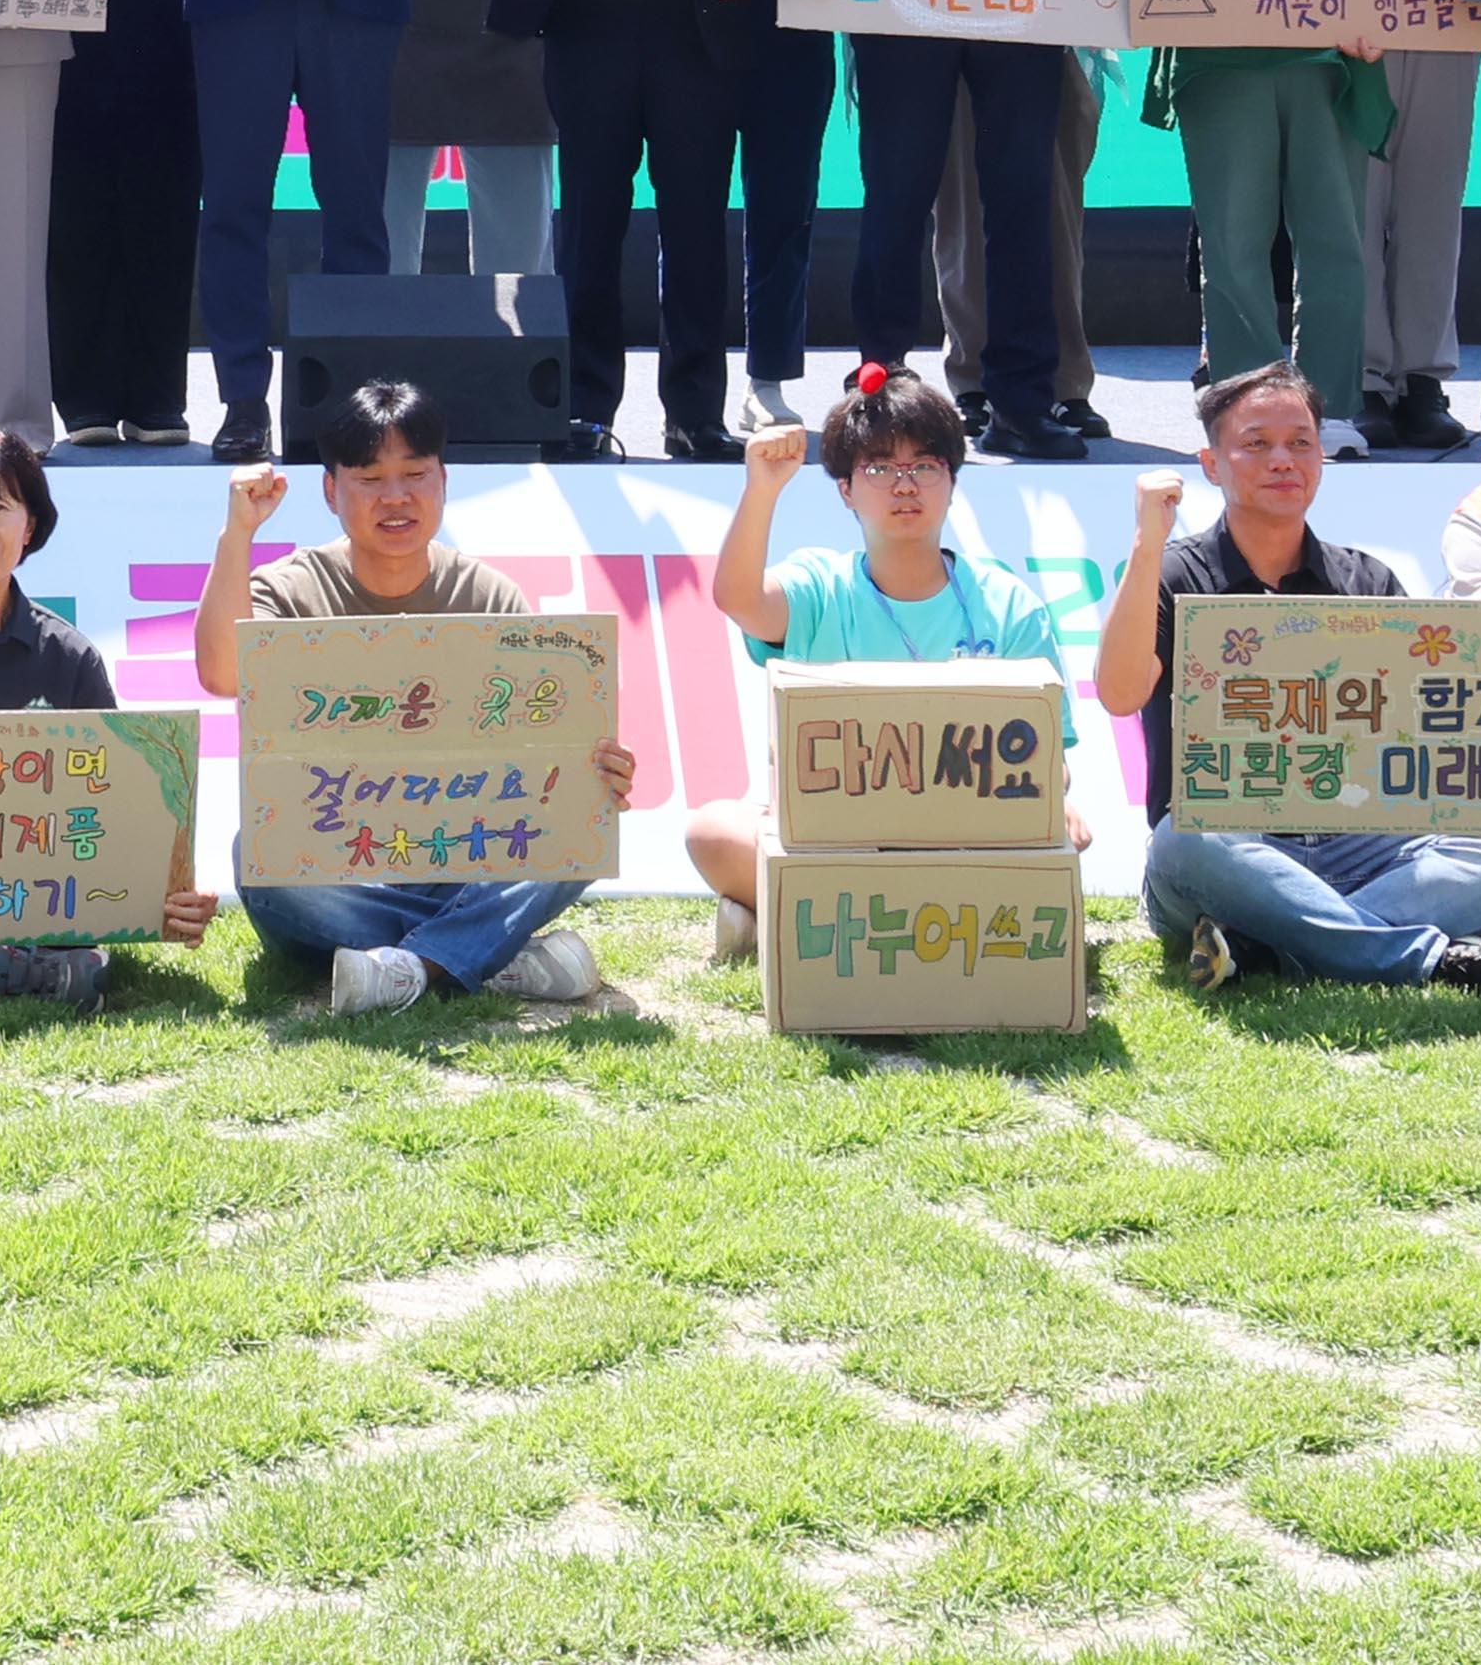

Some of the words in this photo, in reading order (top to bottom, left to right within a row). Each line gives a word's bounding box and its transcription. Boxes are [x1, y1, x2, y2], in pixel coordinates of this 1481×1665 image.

[303, 682, 435, 730] 가까운
[480, 677, 558, 730] 곳은
[1222, 677, 1387, 734] 목재와
[1182, 743, 1343, 800] 친환경
